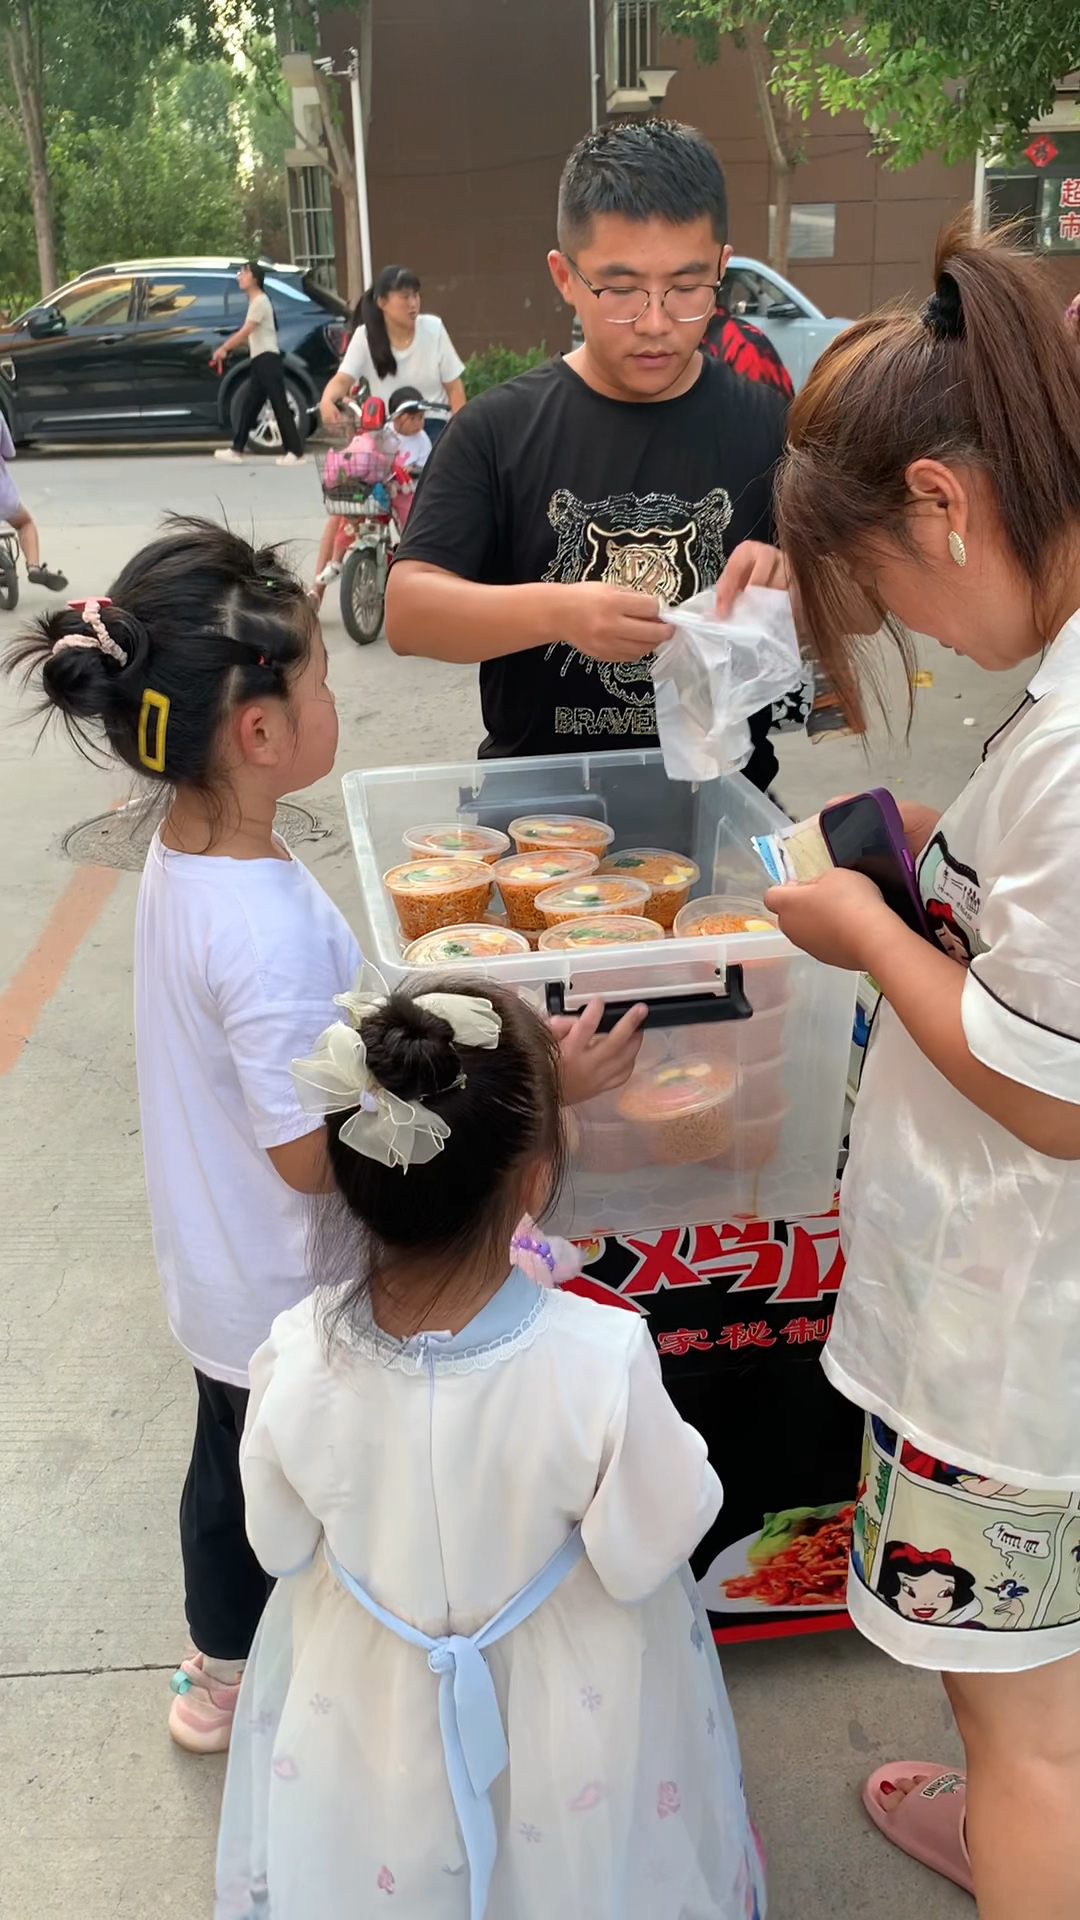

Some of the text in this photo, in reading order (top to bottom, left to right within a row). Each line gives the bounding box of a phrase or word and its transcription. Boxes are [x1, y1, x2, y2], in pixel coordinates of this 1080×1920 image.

[1059, 178, 1080, 240] 超市
[555, 706, 658, 735] BRAVE
[657, 1314, 834, 1356] 家秘制
